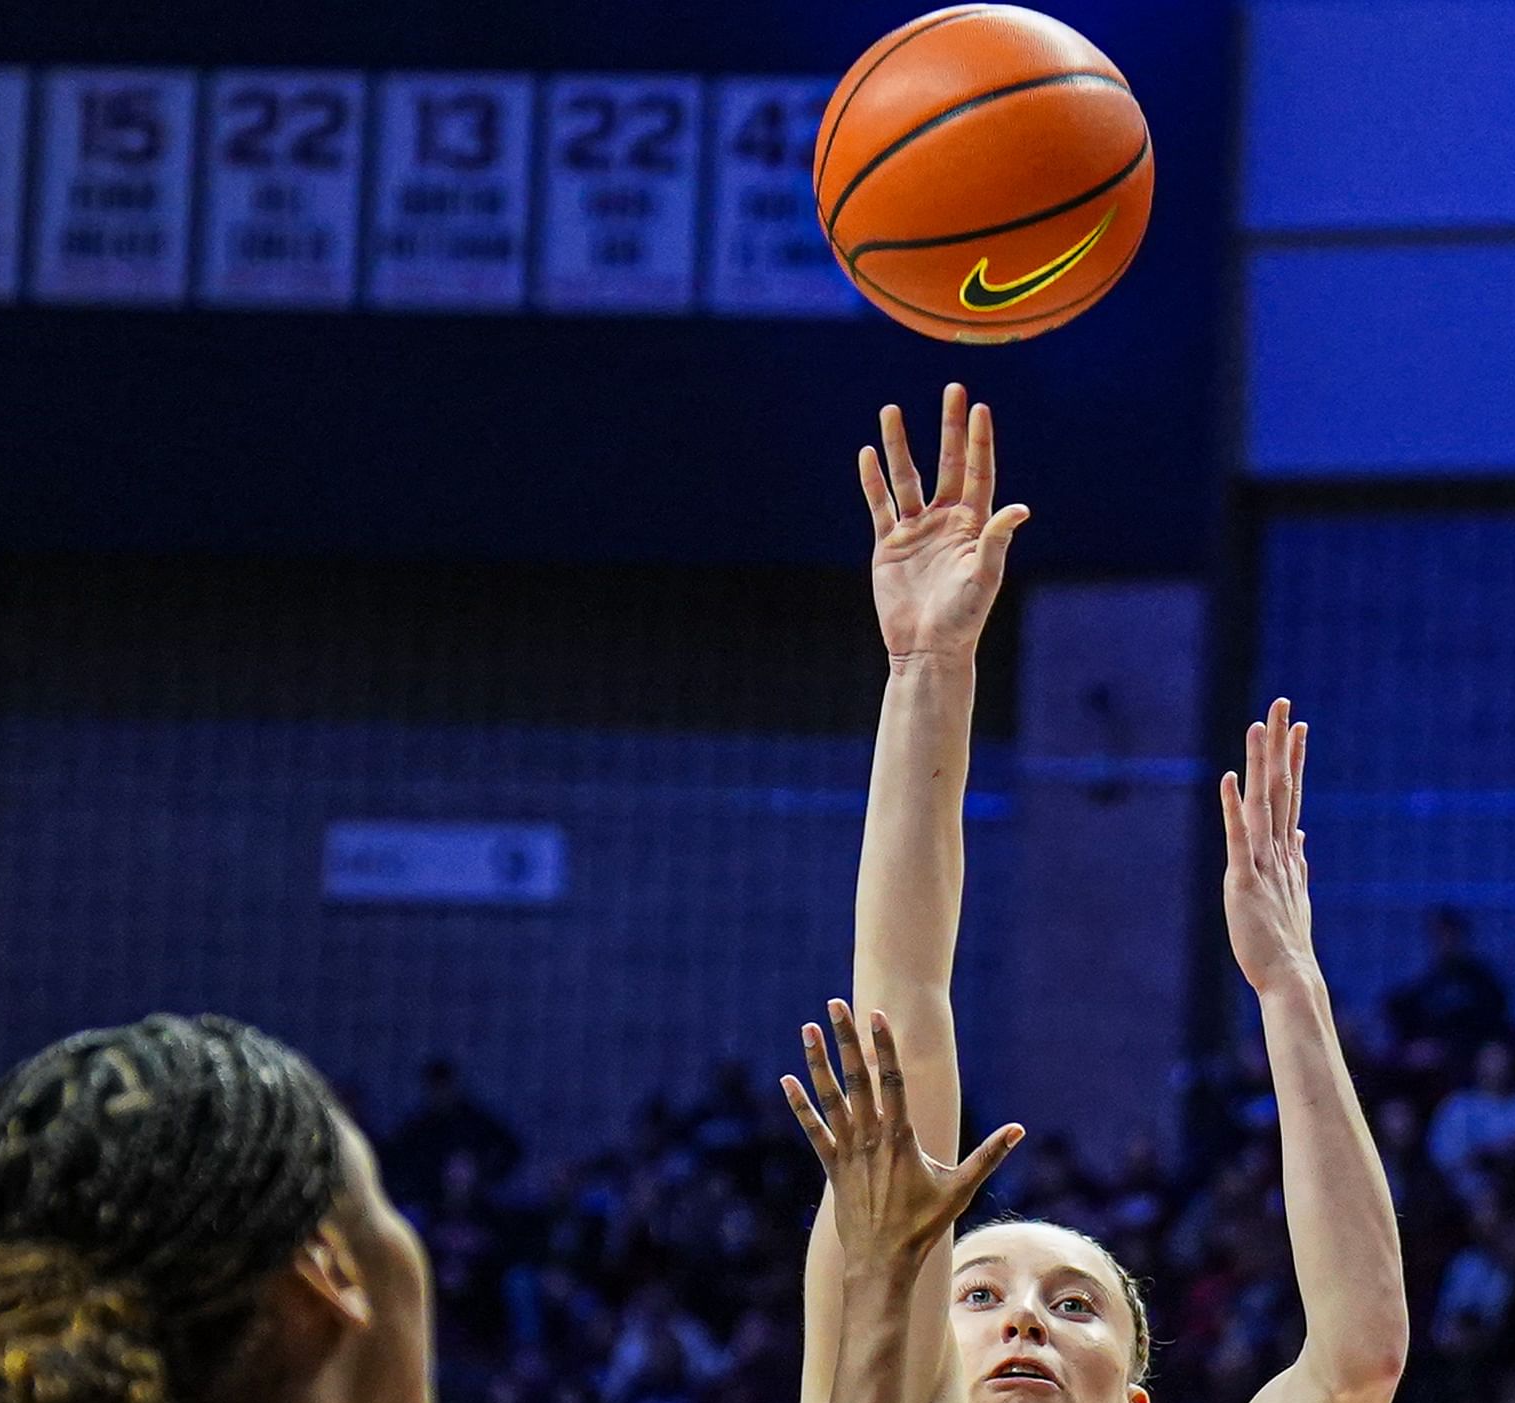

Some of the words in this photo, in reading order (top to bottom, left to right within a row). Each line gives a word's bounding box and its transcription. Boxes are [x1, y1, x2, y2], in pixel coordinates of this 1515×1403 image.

[79, 86, 164, 166] 15
[221, 88, 347, 171] 22
[414, 91, 504, 171] 13
[563, 94, 685, 174] 22
